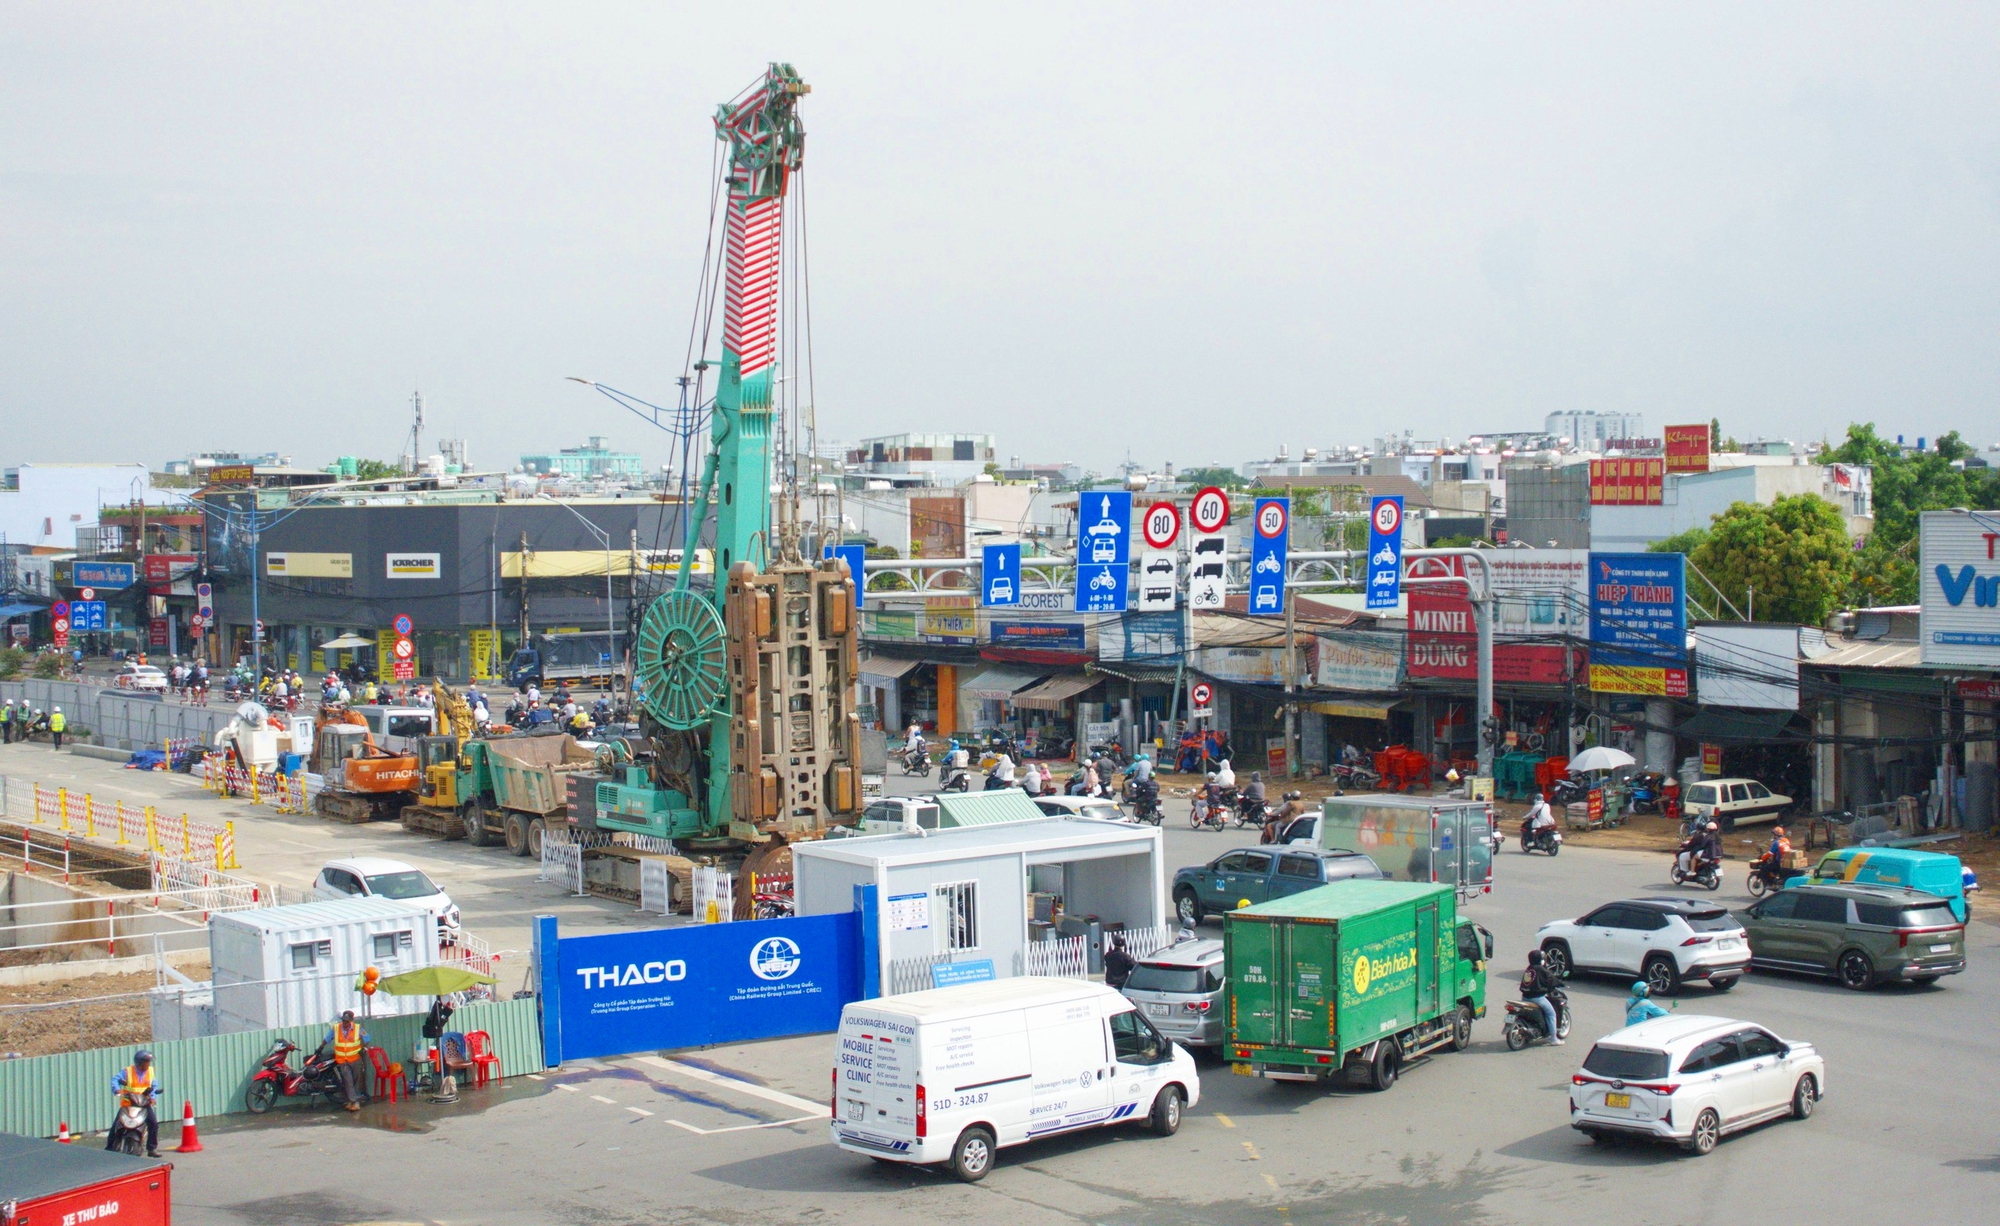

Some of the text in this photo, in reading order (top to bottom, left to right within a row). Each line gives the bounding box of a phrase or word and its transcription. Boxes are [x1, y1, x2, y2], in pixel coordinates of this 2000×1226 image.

[1202, 501, 1218, 520] 60
[1380, 509, 1393, 525] 50
[1153, 515, 1170, 534] 80
[1265, 512, 1278, 528] 50
[392, 558, 434, 567] KÄRCHER
[1382, 597, 1398, 606] BÁNH
[1414, 610, 1467, 633] MINH
[1414, 638, 1468, 667] DŨNG
[376, 769, 420, 781] HITACHI
[1371, 955, 1394, 981] Bách
[1394, 951, 1408, 973] hóa
[577, 959, 686, 990] THACO
[760, 984, 777, 992] Đường
[801, 980, 814, 988] Quốc
[746, 991, 766, 999] Railway
[767, 990, 782, 998] Group
[630, 1003, 656, 1011] Corporation
[845, 1016, 887, 1029] VOLKSWAGEN
[951, 1025, 971, 1034] Servicing
[950, 1034, 972, 1042] Inspection
[842, 1039, 874, 1054] MOBILE
[878, 1045, 896, 1054] Servicing
[946, 1042, 973, 1052] MOT repairs
[841, 1053, 873, 1069] SERVICE
[877, 1054, 897, 1062] Inspection
[959, 1051, 974, 1059] service
[886, 1064, 901, 1072] repairs
[935, 1059, 975, 1072] Free health checks
[846, 1069, 872, 1083] CLINIC
[1034, 1077, 1077, 1091] Volkswagen Saigon
[933, 1092, 989, 1111] 51D 324.87
[1029, 1101, 1068, 1116] SERVICE 24/7
[1069, 1112, 1104, 1124] MOBILE SERVICE
[63, 1200, 119, 1226] XE THƯ BÁO
